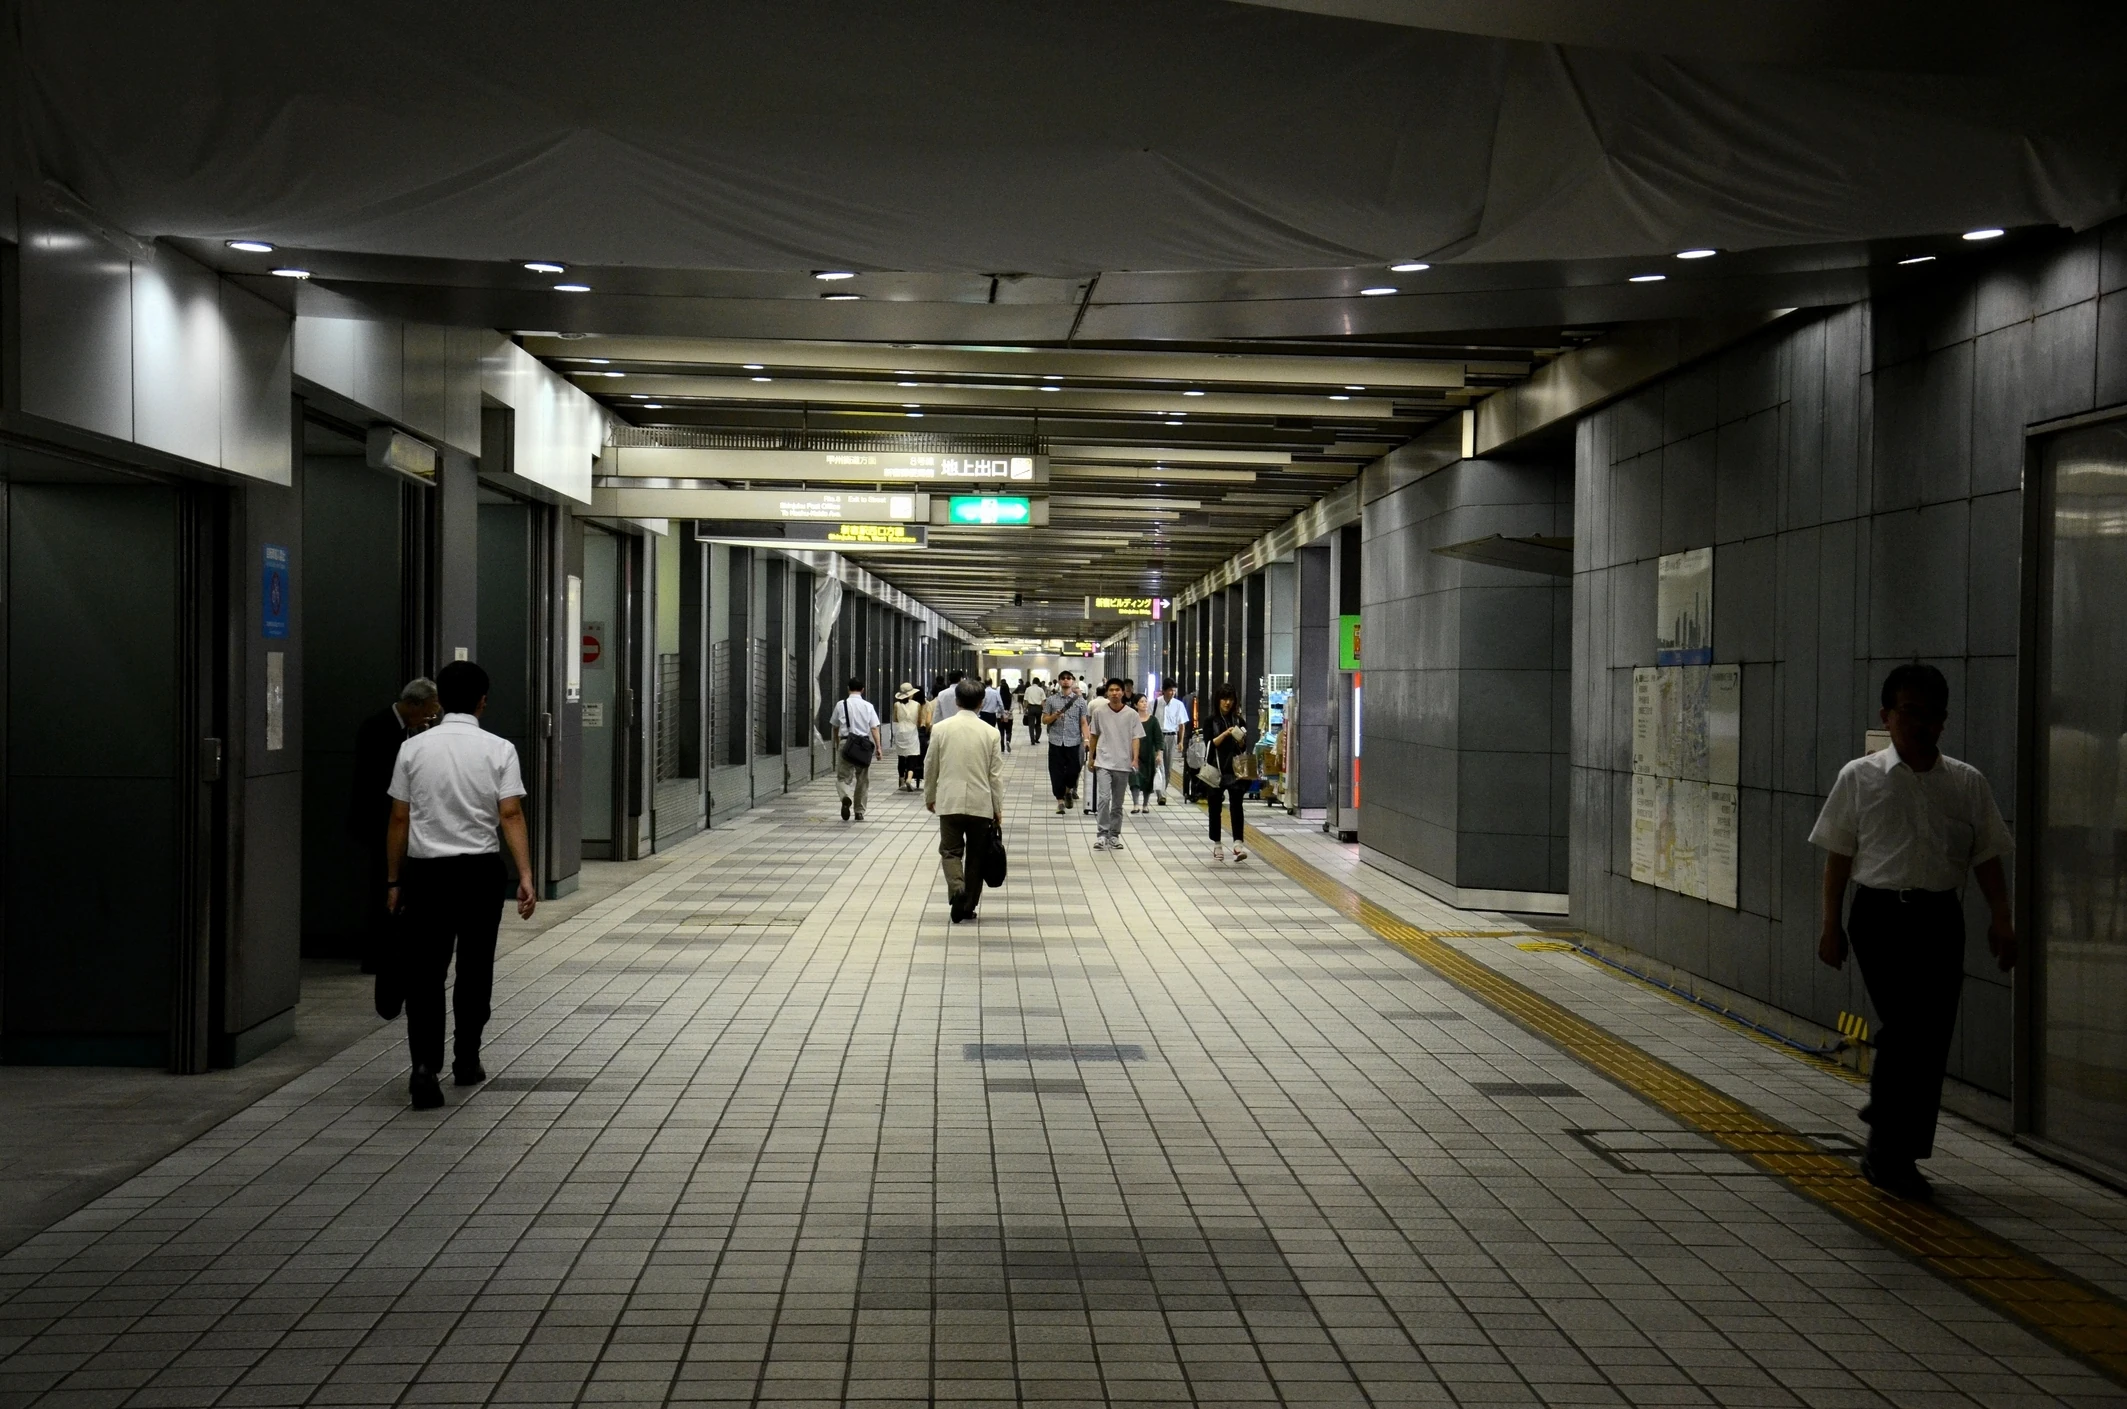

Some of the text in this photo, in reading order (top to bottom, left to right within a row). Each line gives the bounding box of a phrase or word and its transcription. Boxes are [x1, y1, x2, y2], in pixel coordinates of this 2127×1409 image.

[941, 459, 1008, 478] 地上出口
[1095, 597, 1152, 608] 新宿ビルディング
